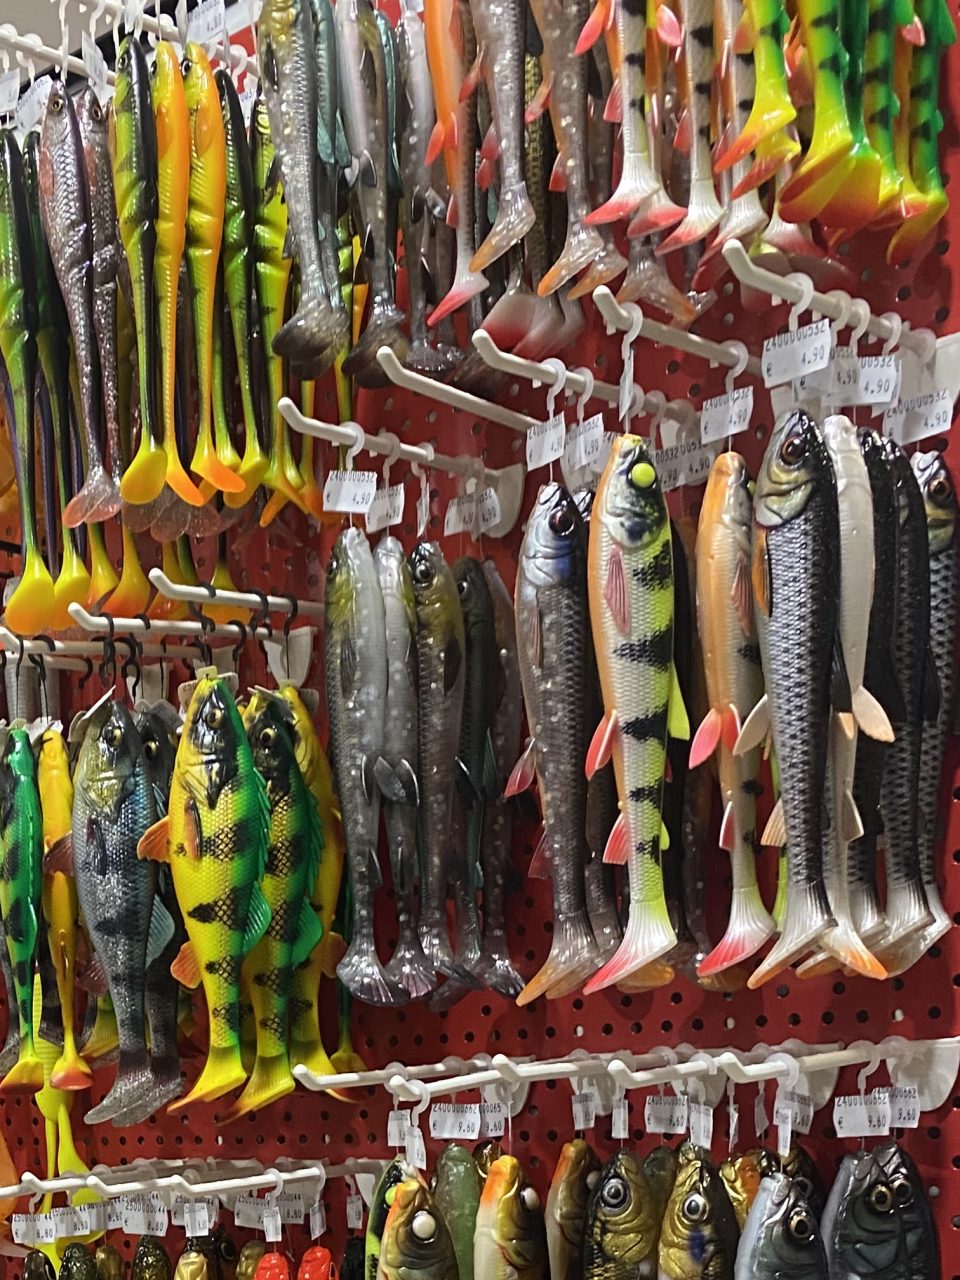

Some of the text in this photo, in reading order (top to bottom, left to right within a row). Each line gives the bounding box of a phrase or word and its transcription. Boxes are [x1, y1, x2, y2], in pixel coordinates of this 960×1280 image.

[801, 347, 825, 365] 4.90
[864, 379, 890, 395] 4.90
[924, 411, 948, 430] 4.90
[352, 493, 371, 505] 4.90
[458, 1122, 476, 1133] 9.60
[868, 1116, 887, 1129] 9.60
